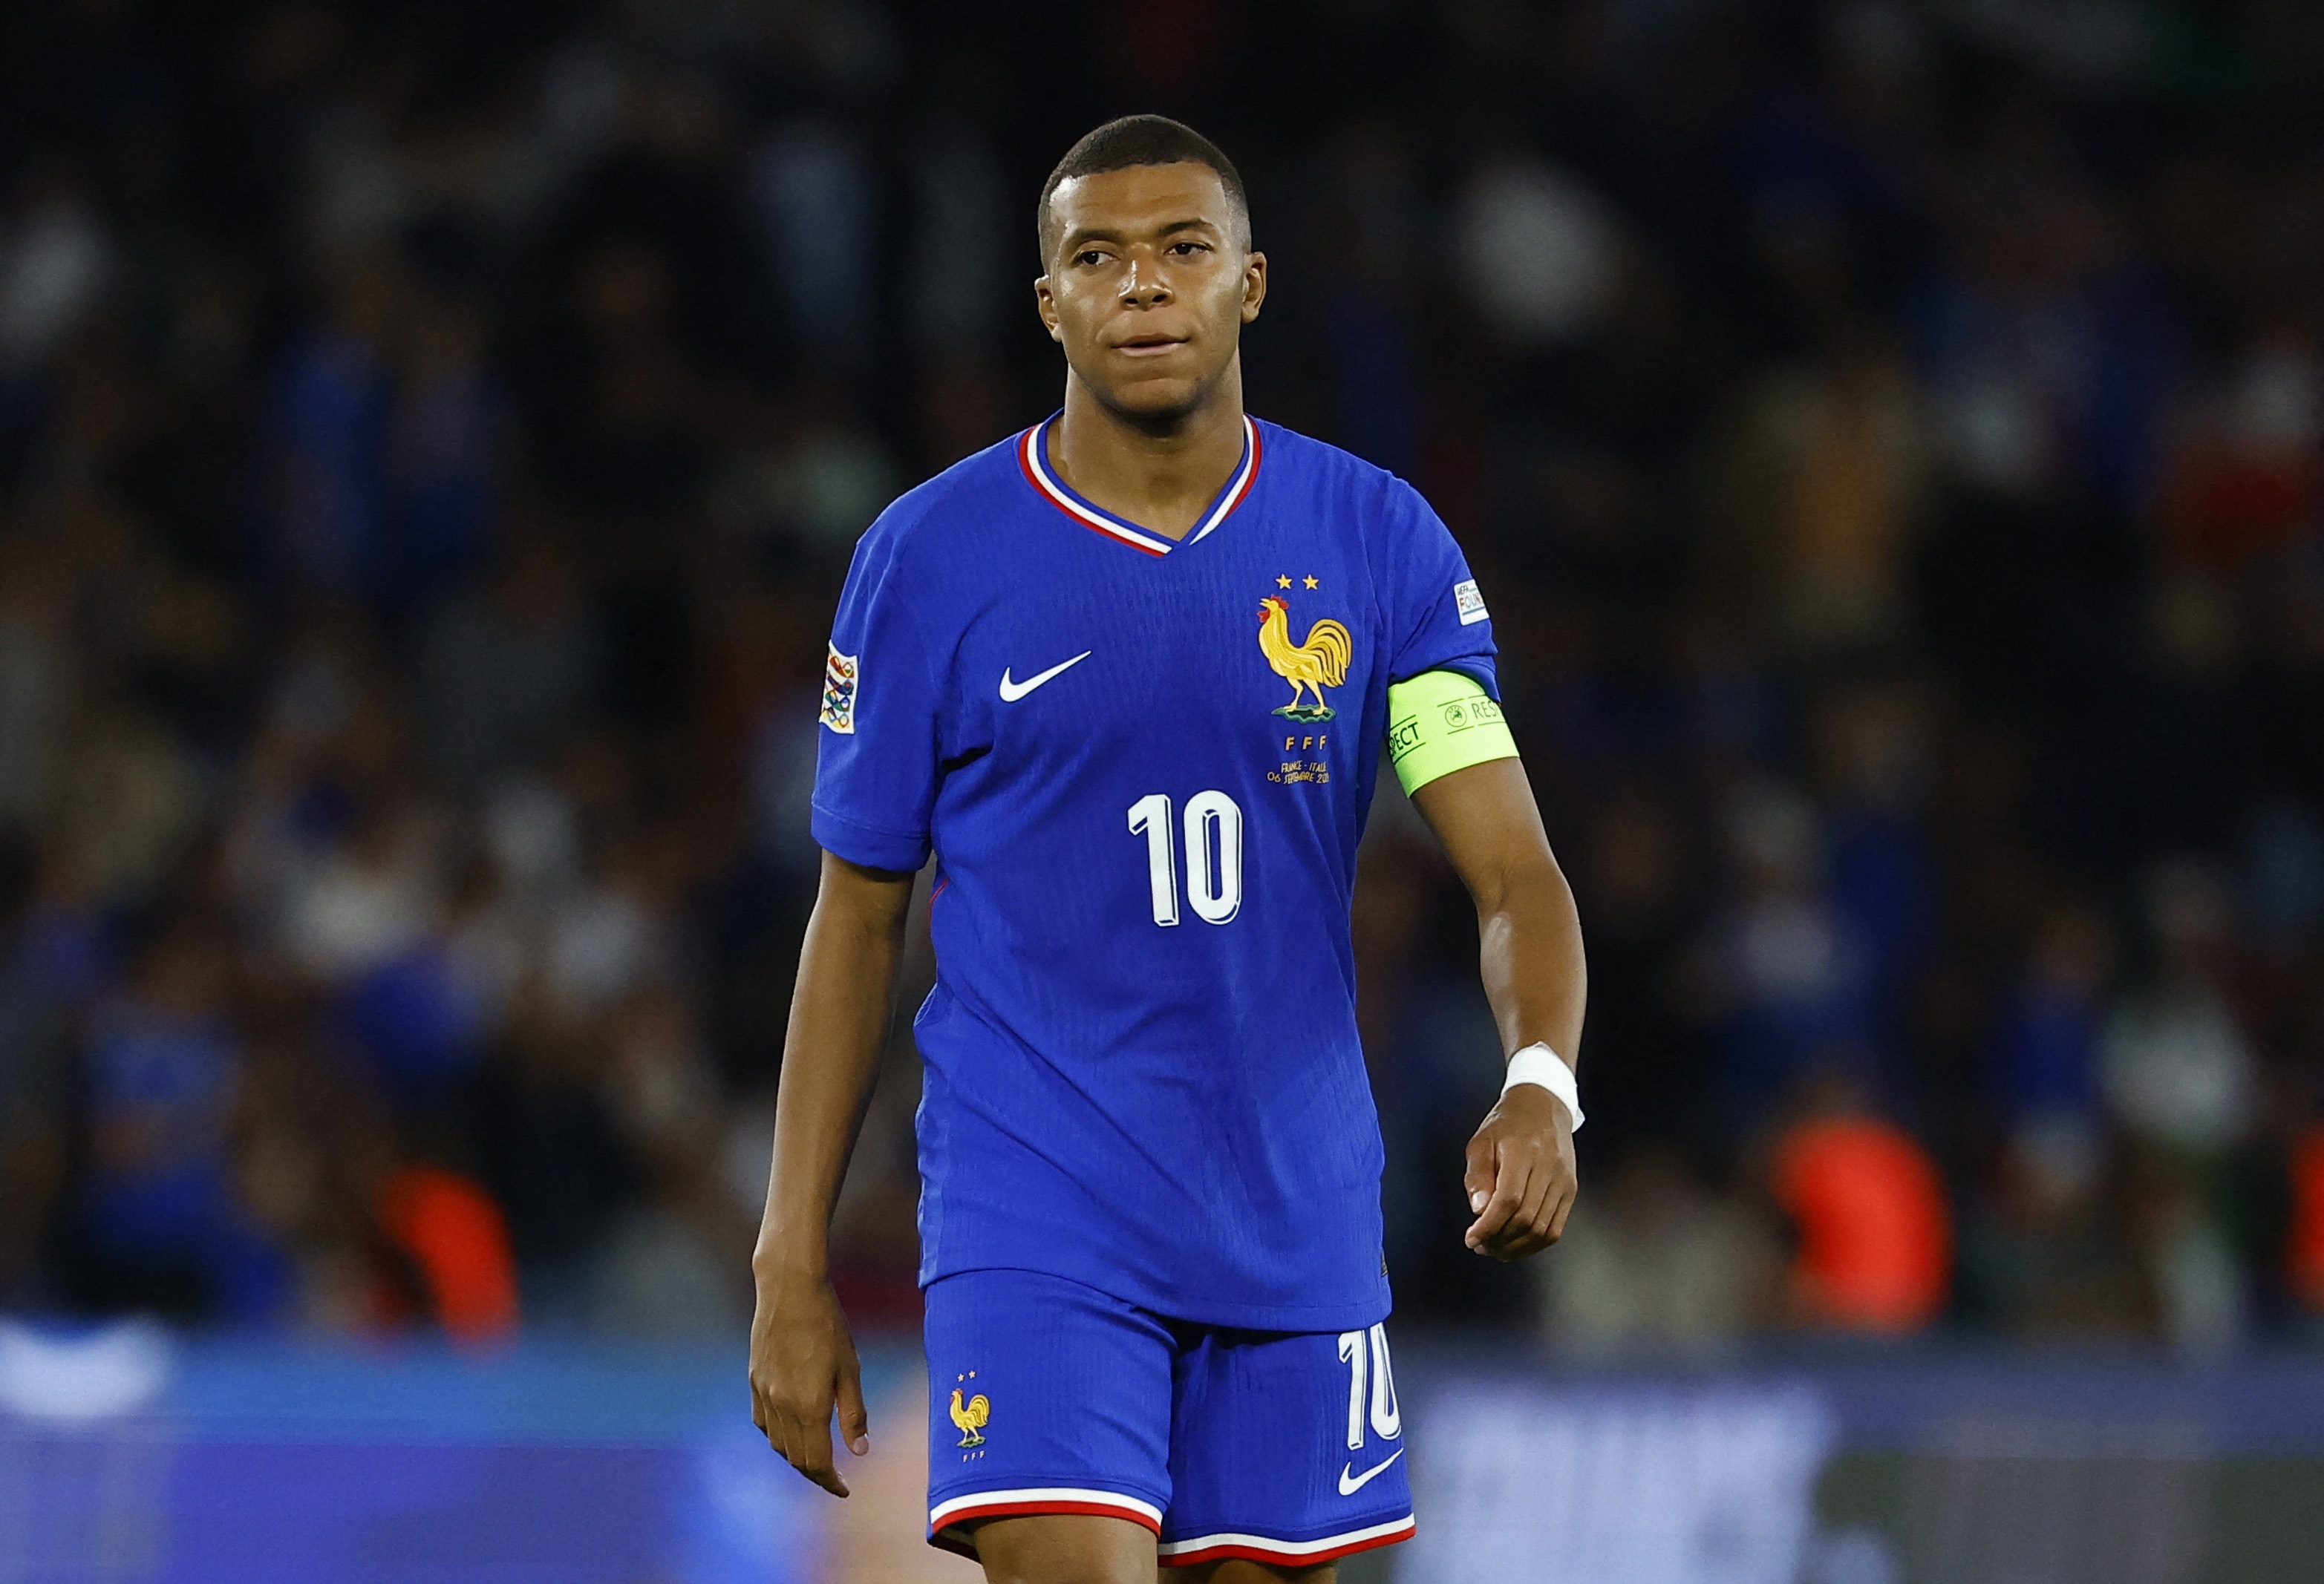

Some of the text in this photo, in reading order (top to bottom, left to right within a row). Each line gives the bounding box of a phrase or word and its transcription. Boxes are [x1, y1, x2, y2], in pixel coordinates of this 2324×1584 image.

[1267, 771, 1282, 783] 06
[1128, 790, 1243, 927] 10
[1338, 1322, 1402, 1450] 10
